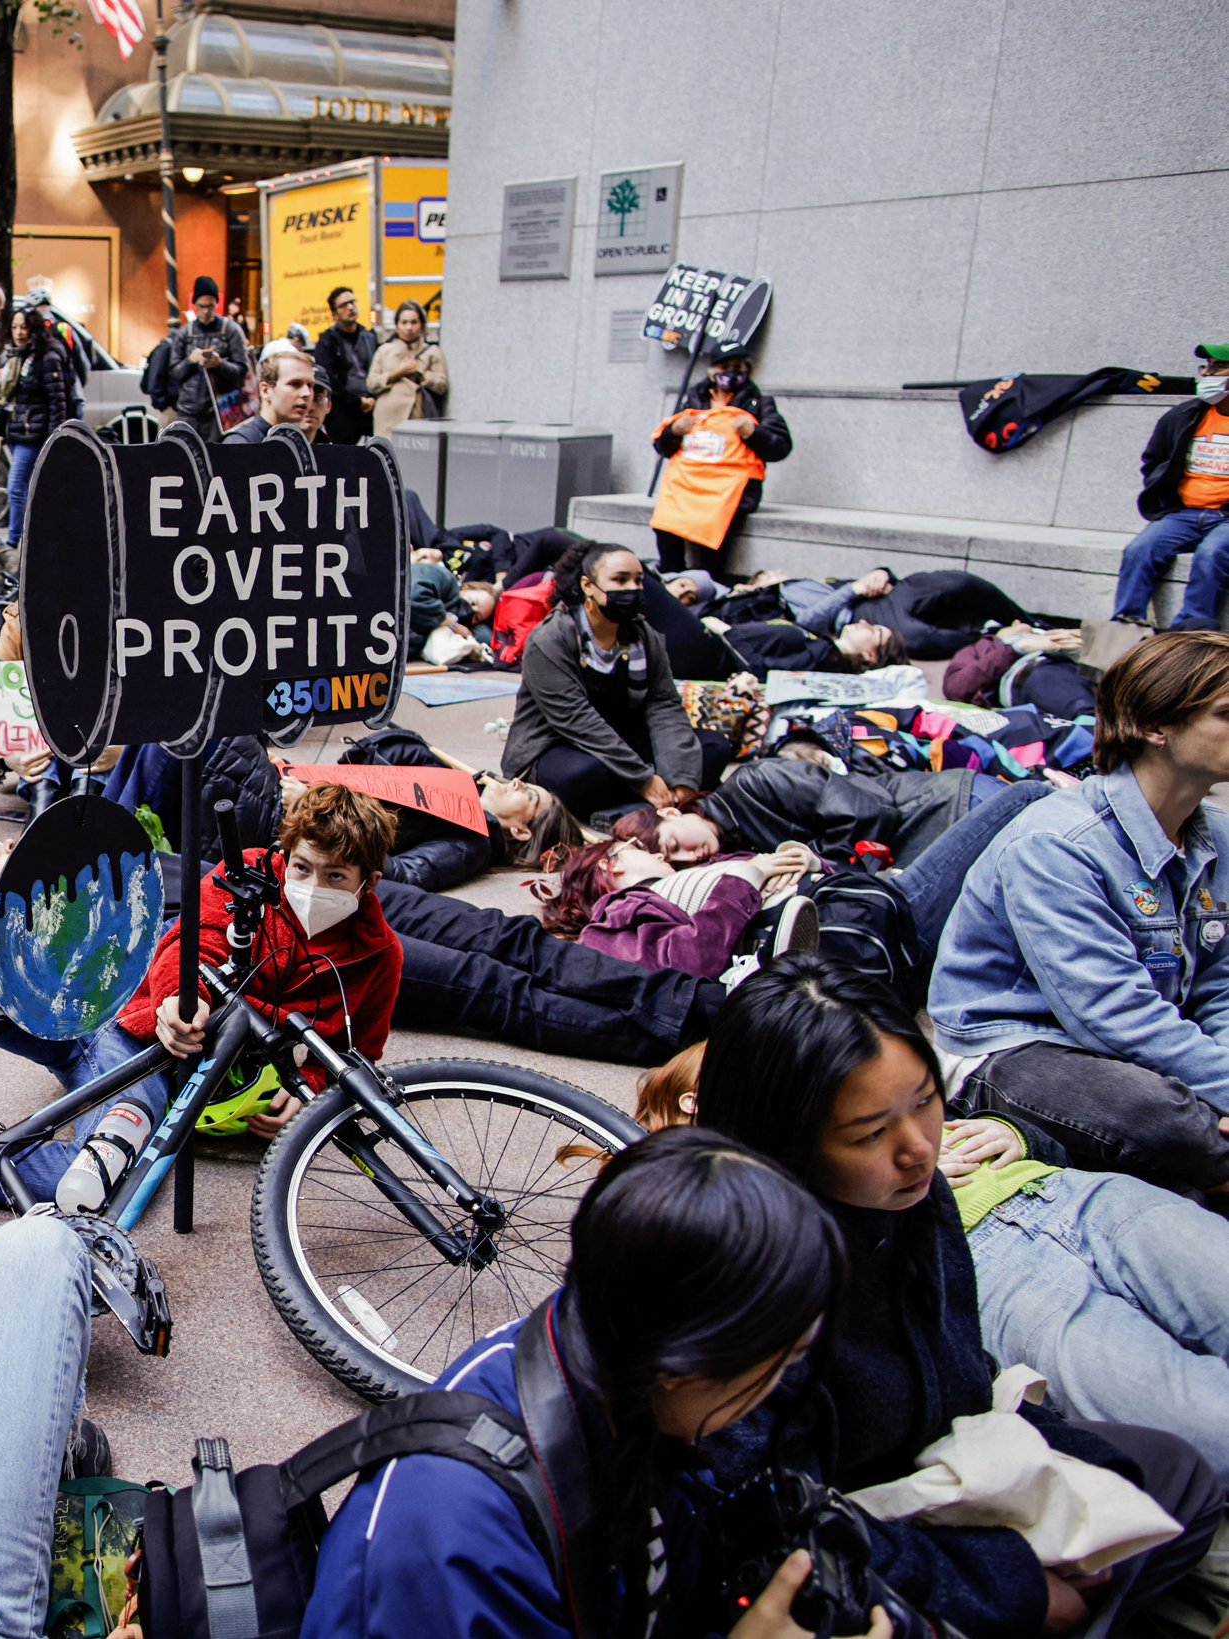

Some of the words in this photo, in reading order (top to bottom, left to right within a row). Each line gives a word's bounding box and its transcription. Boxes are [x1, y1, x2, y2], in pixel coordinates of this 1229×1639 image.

[283, 203, 360, 233] PENSKE
[597, 248, 621, 258] OPEN
[623, 247, 635, 257] TO
[635, 243, 670, 256] PUBLIC
[667, 268, 721, 295] KEEP
[721, 282, 746, 302] IT
[662, 286, 688, 308] IN
[688, 292, 730, 320] THE
[510, 442, 547, 458] PAPER
[1194, 458, 1229, 471] CHANG
[149, 474, 369, 537] EARTH
[173, 543, 352, 605] OVER
[116, 611, 397, 677] PROFITS
[270, 672, 388, 717] 350NYC
[413, 782, 487, 831] ACTION
[1145, 961, 1176, 969] Bernie
[134, 1056, 218, 1168] TREK
